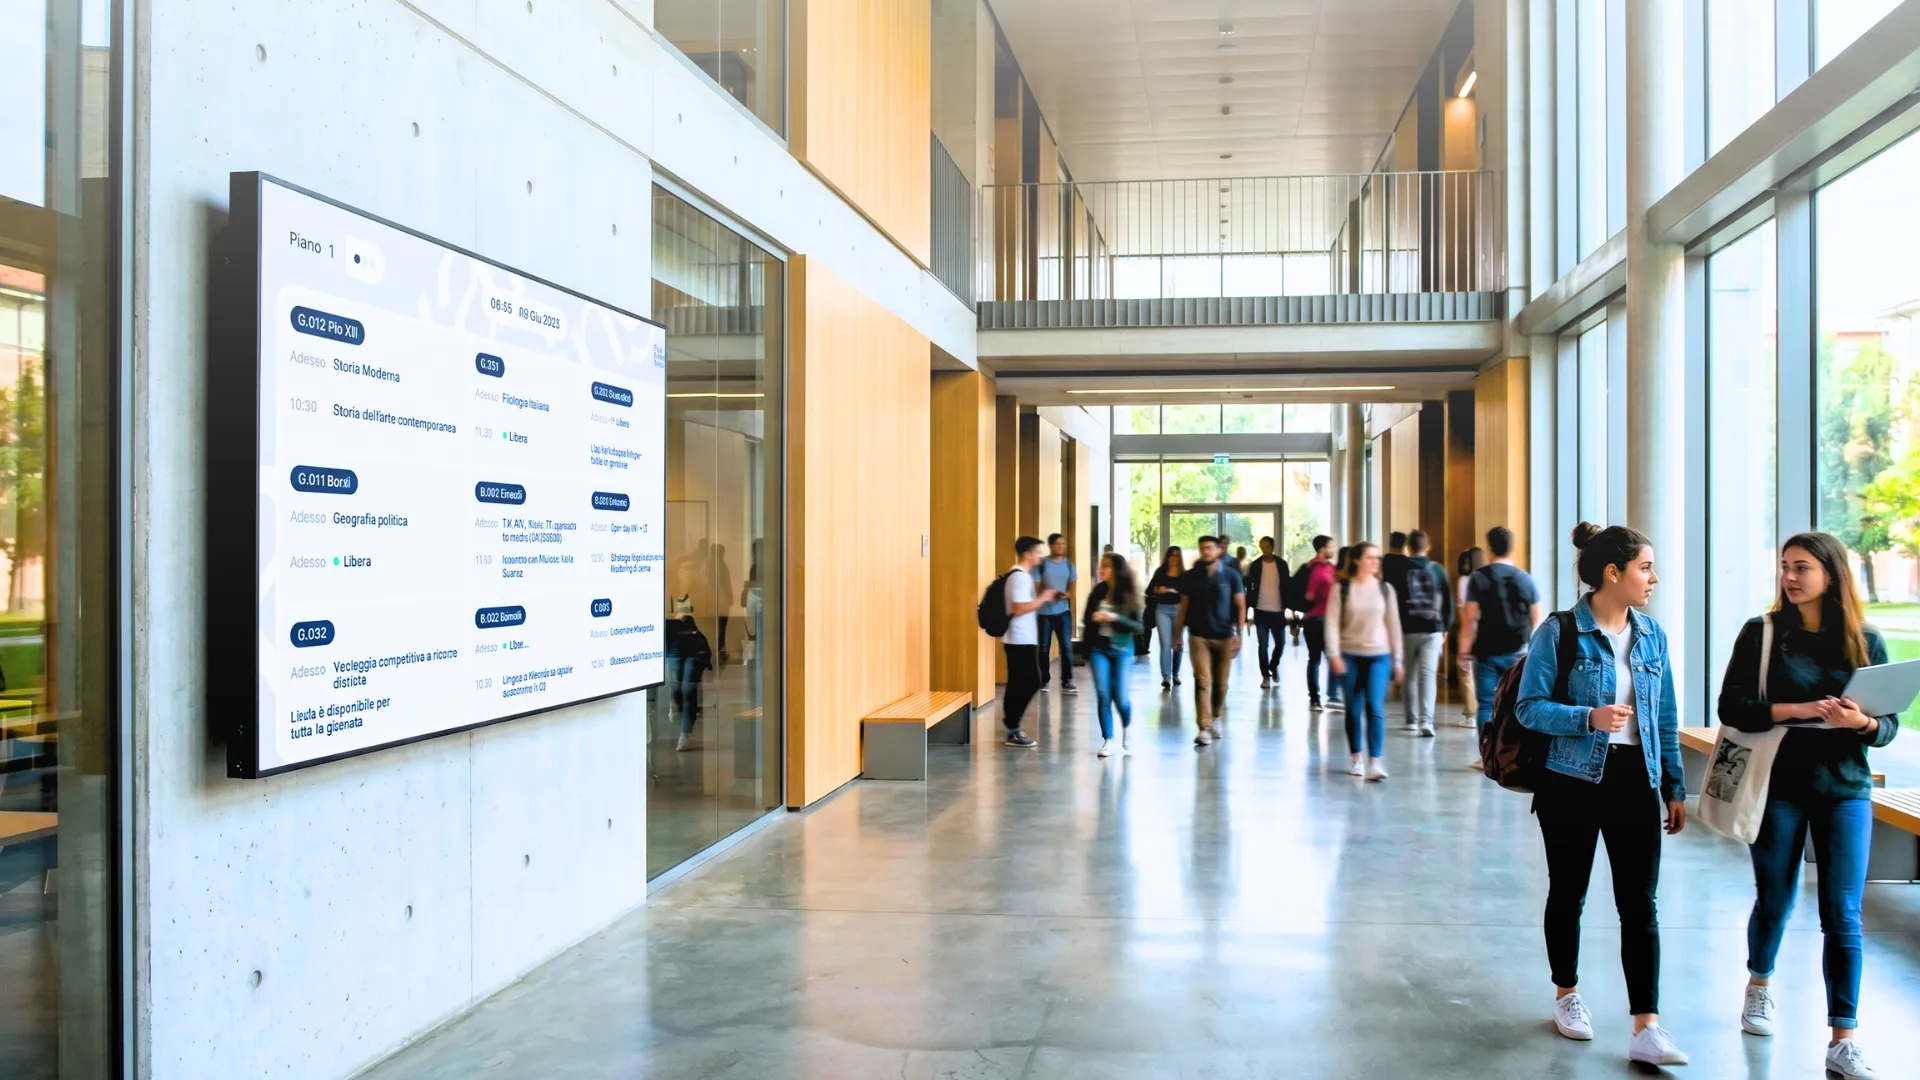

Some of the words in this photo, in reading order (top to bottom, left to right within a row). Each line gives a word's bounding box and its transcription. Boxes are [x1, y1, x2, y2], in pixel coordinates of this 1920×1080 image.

[290, 231, 321, 254] Piano
[329, 245, 334, 258] 1
[298, 313, 326, 332] G.012
[328, 320, 343, 335] Pio
[530, 311, 541, 323] Giu
[543, 315, 560, 329] 2023
[290, 350, 326, 367] Adesso
[333, 358, 360, 375] Storia
[362, 364, 400, 383] Moderna
[475, 388, 498, 401] Adesso
[290, 398, 317, 413] 10:30
[333, 404, 360, 419] Storia
[398, 416, 457, 434] contemporanea
[510, 431, 528, 443] Libera
[298, 472, 324, 487] G.011
[290, 510, 326, 523] Adesso
[333, 512, 376, 527] Geografia
[378, 514, 408, 528] politica
[475, 517, 498, 528] Adesso
[290, 555, 326, 568] Adesso
[344, 555, 371, 567] Libera
[502, 568, 523, 578] Suarez
[297, 627, 327, 641] G.032
[475, 643, 498, 654] Adesso
[291, 664, 326, 679] Adesso
[378, 653, 425, 668] competitiva
[427, 653, 431, 661] a
[319, 706, 324, 718] è
[327, 698, 375, 718] disponibile
[377, 698, 390, 712] per
[291, 725, 312, 739] tutta
[316, 723, 324, 735] la
